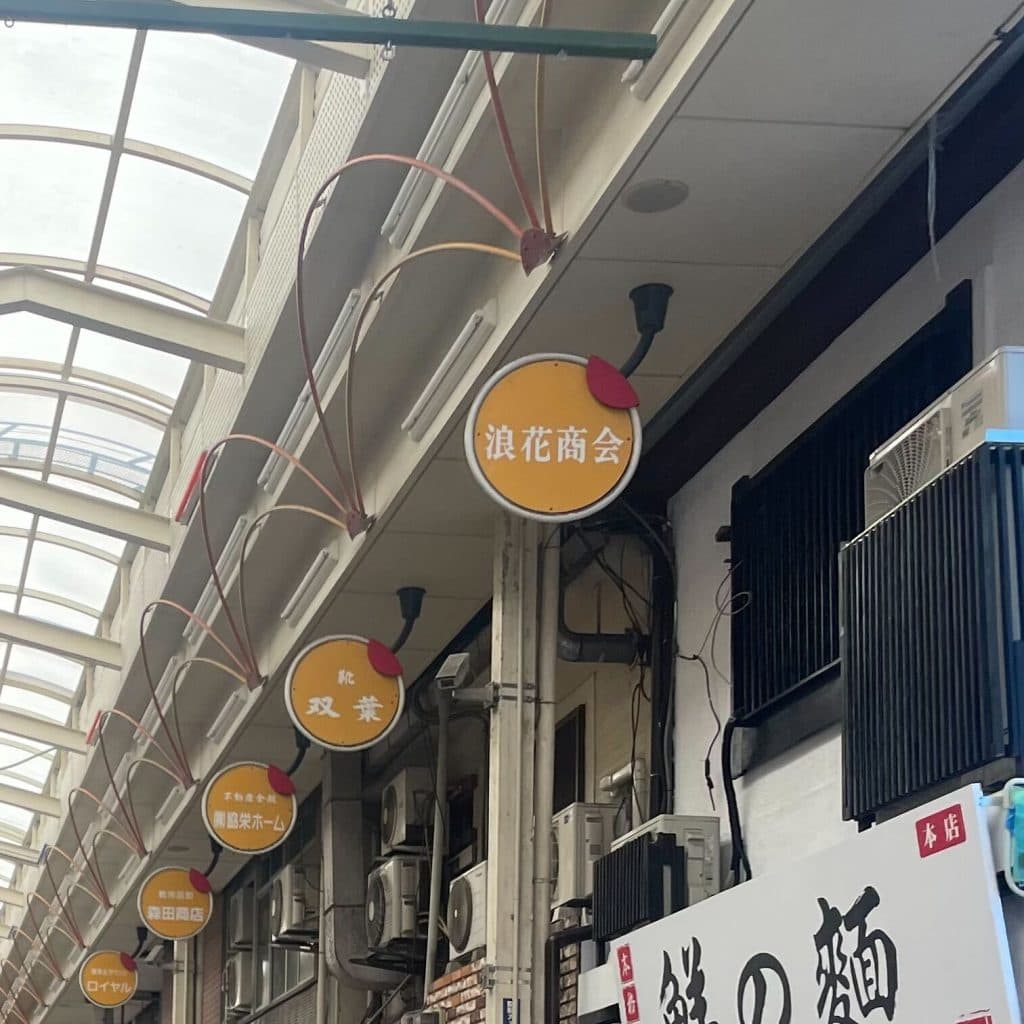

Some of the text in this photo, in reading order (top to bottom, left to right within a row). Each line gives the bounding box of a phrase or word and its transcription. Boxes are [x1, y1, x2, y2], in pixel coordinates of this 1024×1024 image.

[484, 424, 624, 465] 浪花商会
[306, 694, 384, 722] 双葉
[922, 812, 959, 849] 本店
[87, 980, 133, 993] ロイヤル
